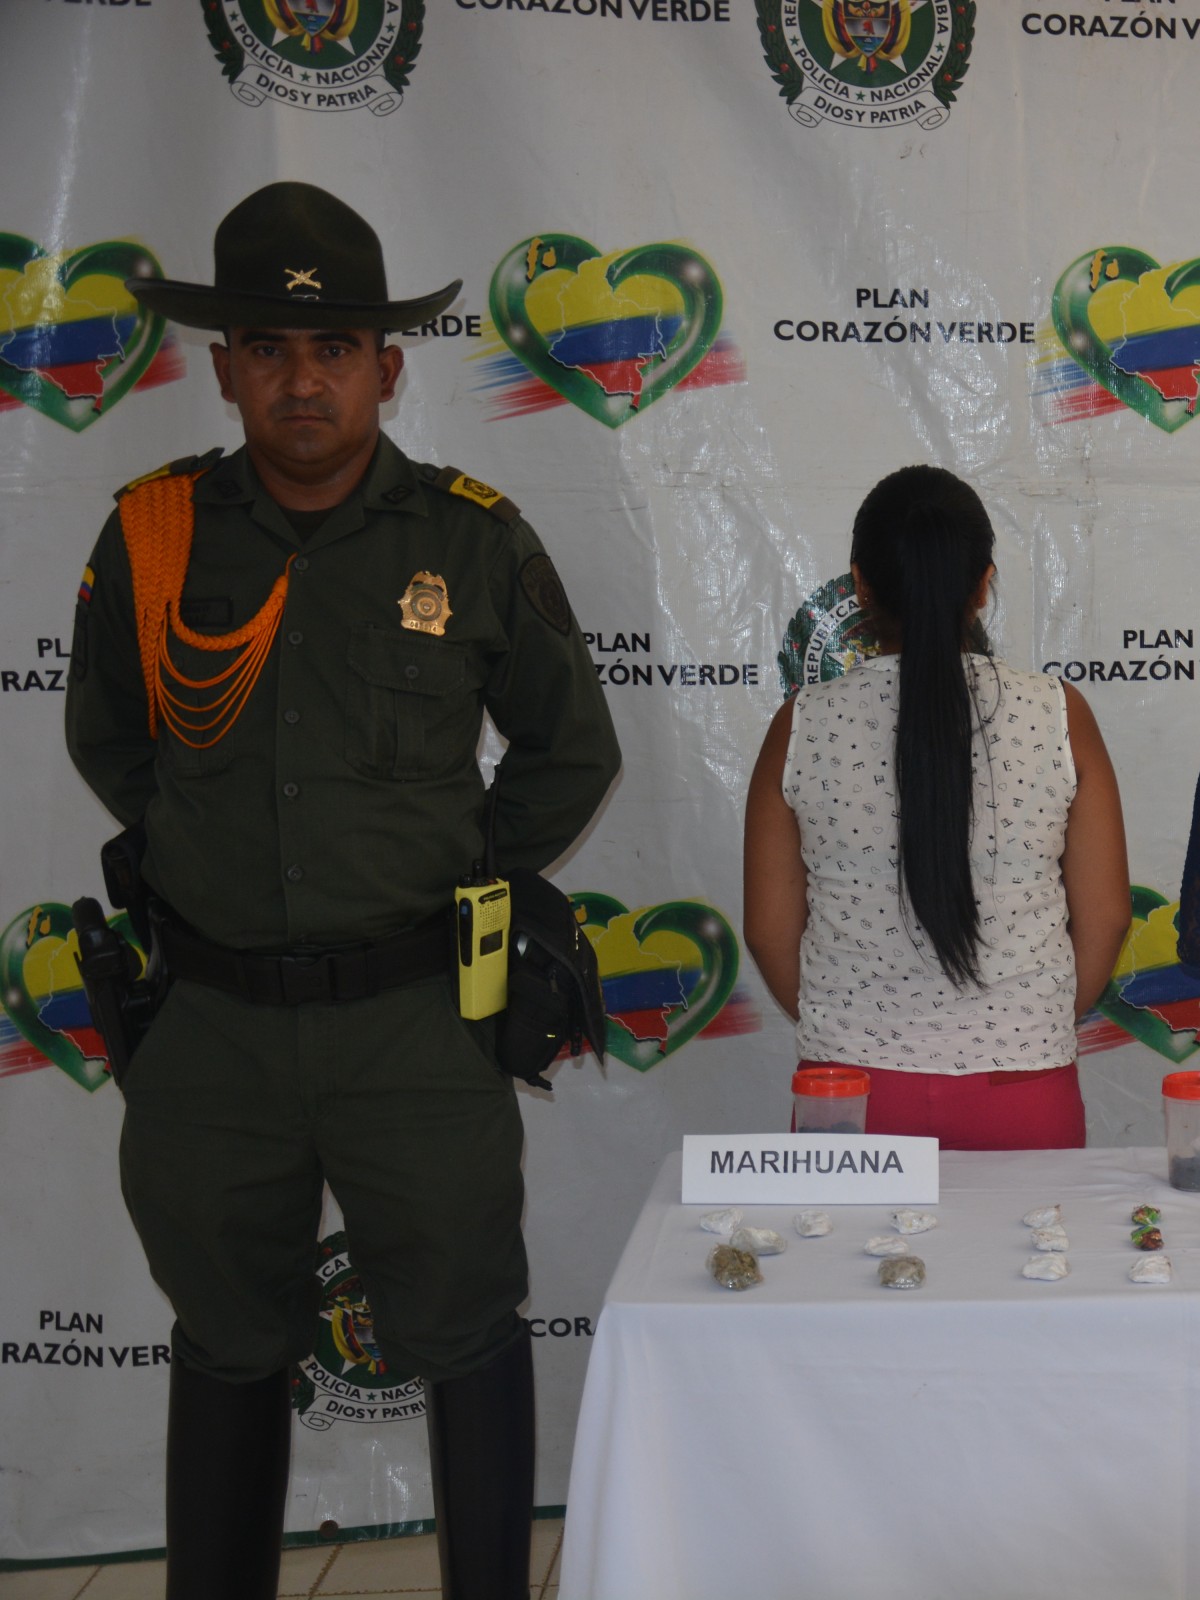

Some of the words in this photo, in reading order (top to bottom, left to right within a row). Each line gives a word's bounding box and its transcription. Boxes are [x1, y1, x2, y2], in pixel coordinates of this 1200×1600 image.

[633, 0, 731, 22] VERDE
[1021, 10, 1177, 39] CORAZÓN
[316, 34, 395, 85] NACIONAL
[870, 53, 944, 103] NACIONAL
[317, 84, 377, 107] PATRIA
[870, 99, 926, 124] PATRIA
[856, 288, 929, 308] PLAN
[388, 315, 482, 337] RDE
[773, 315, 931, 343] CORAZÓN
[936, 321, 1036, 344] VERDE
[37, 638, 71, 658] PL
[582, 632, 650, 653] PLAN
[1123, 629, 1194, 649] PLAN
[657, 664, 759, 686] VERDE
[710, 1150, 904, 1174] MARIHUANA
[39, 1310, 103, 1334] PLAN
[1, 1338, 104, 1368] RAZÓN
[109, 1344, 171, 1368] VER
[382, 1400, 426, 1419] PATRI
